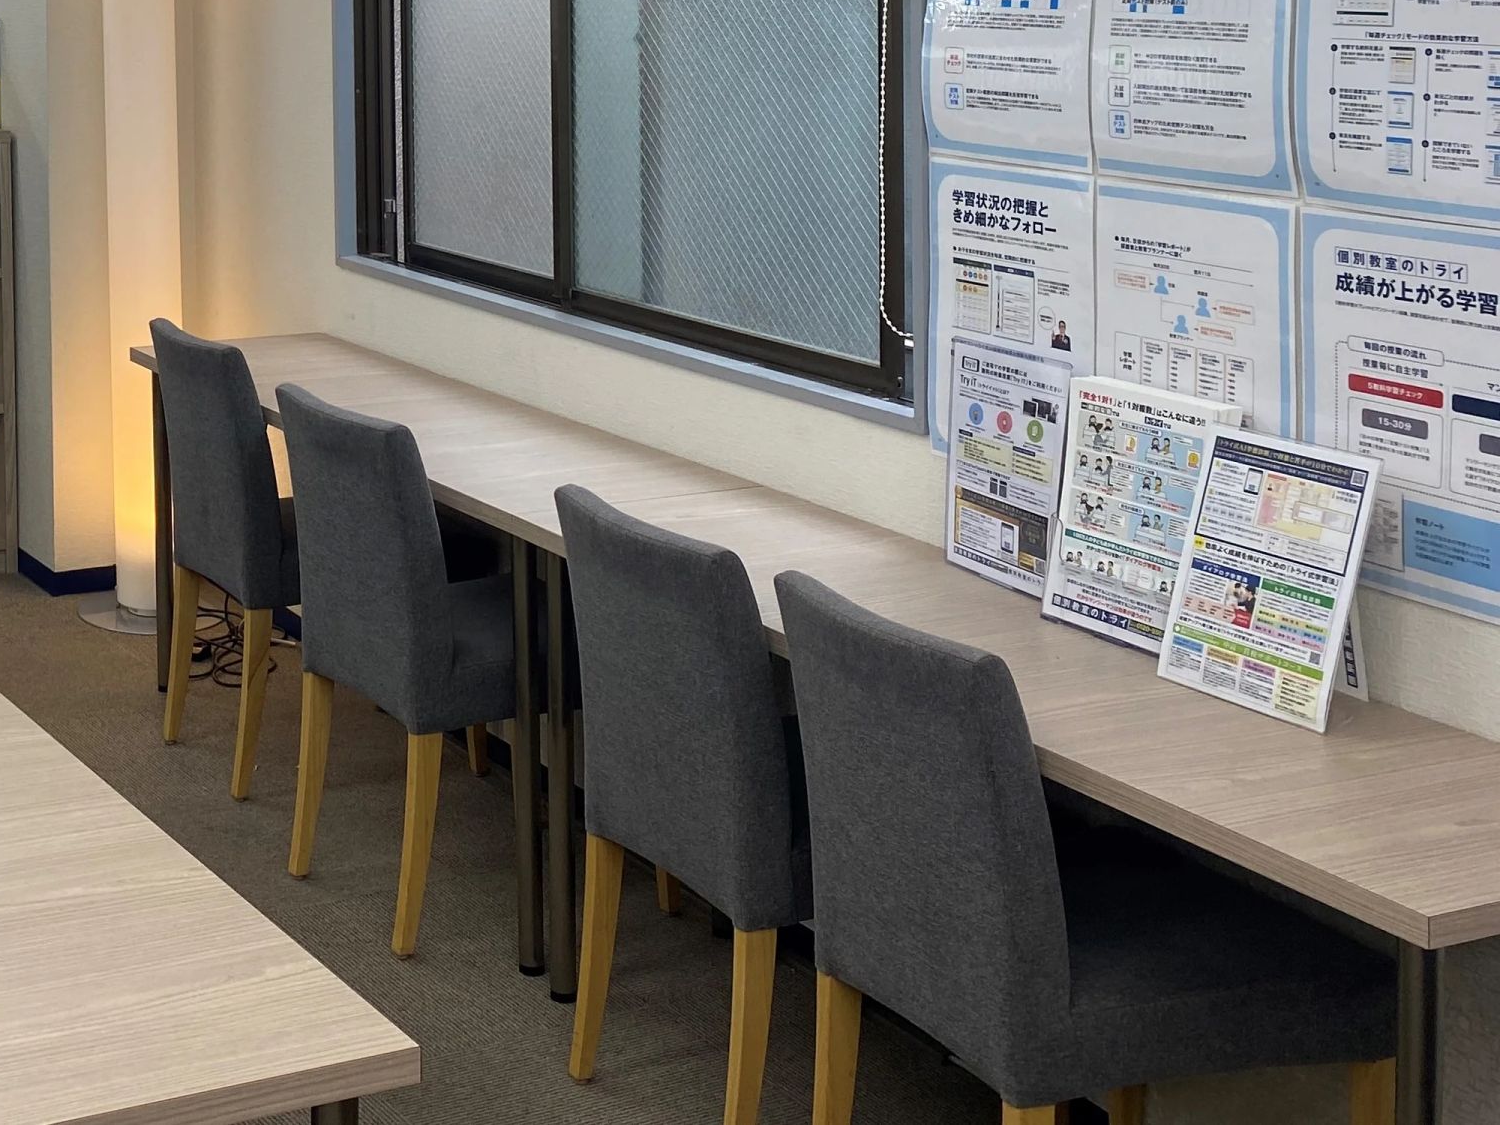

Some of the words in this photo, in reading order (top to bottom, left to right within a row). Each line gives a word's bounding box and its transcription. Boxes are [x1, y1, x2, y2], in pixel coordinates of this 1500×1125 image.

[952, 189, 1049, 218] 学習状況の把握と
[952, 207, 1057, 235] きめ細かなフォロー
[1337, 250, 1464, 280] 個別教室のトライ
[1335, 272, 1499, 316] 成績が上がる学習
[1363, 341, 1427, 360] 毎回の授業の流れ
[1362, 358, 1429, 379] 授業毎に自主学習
[1053, 595, 1129, 628] 個別教室のトライ
